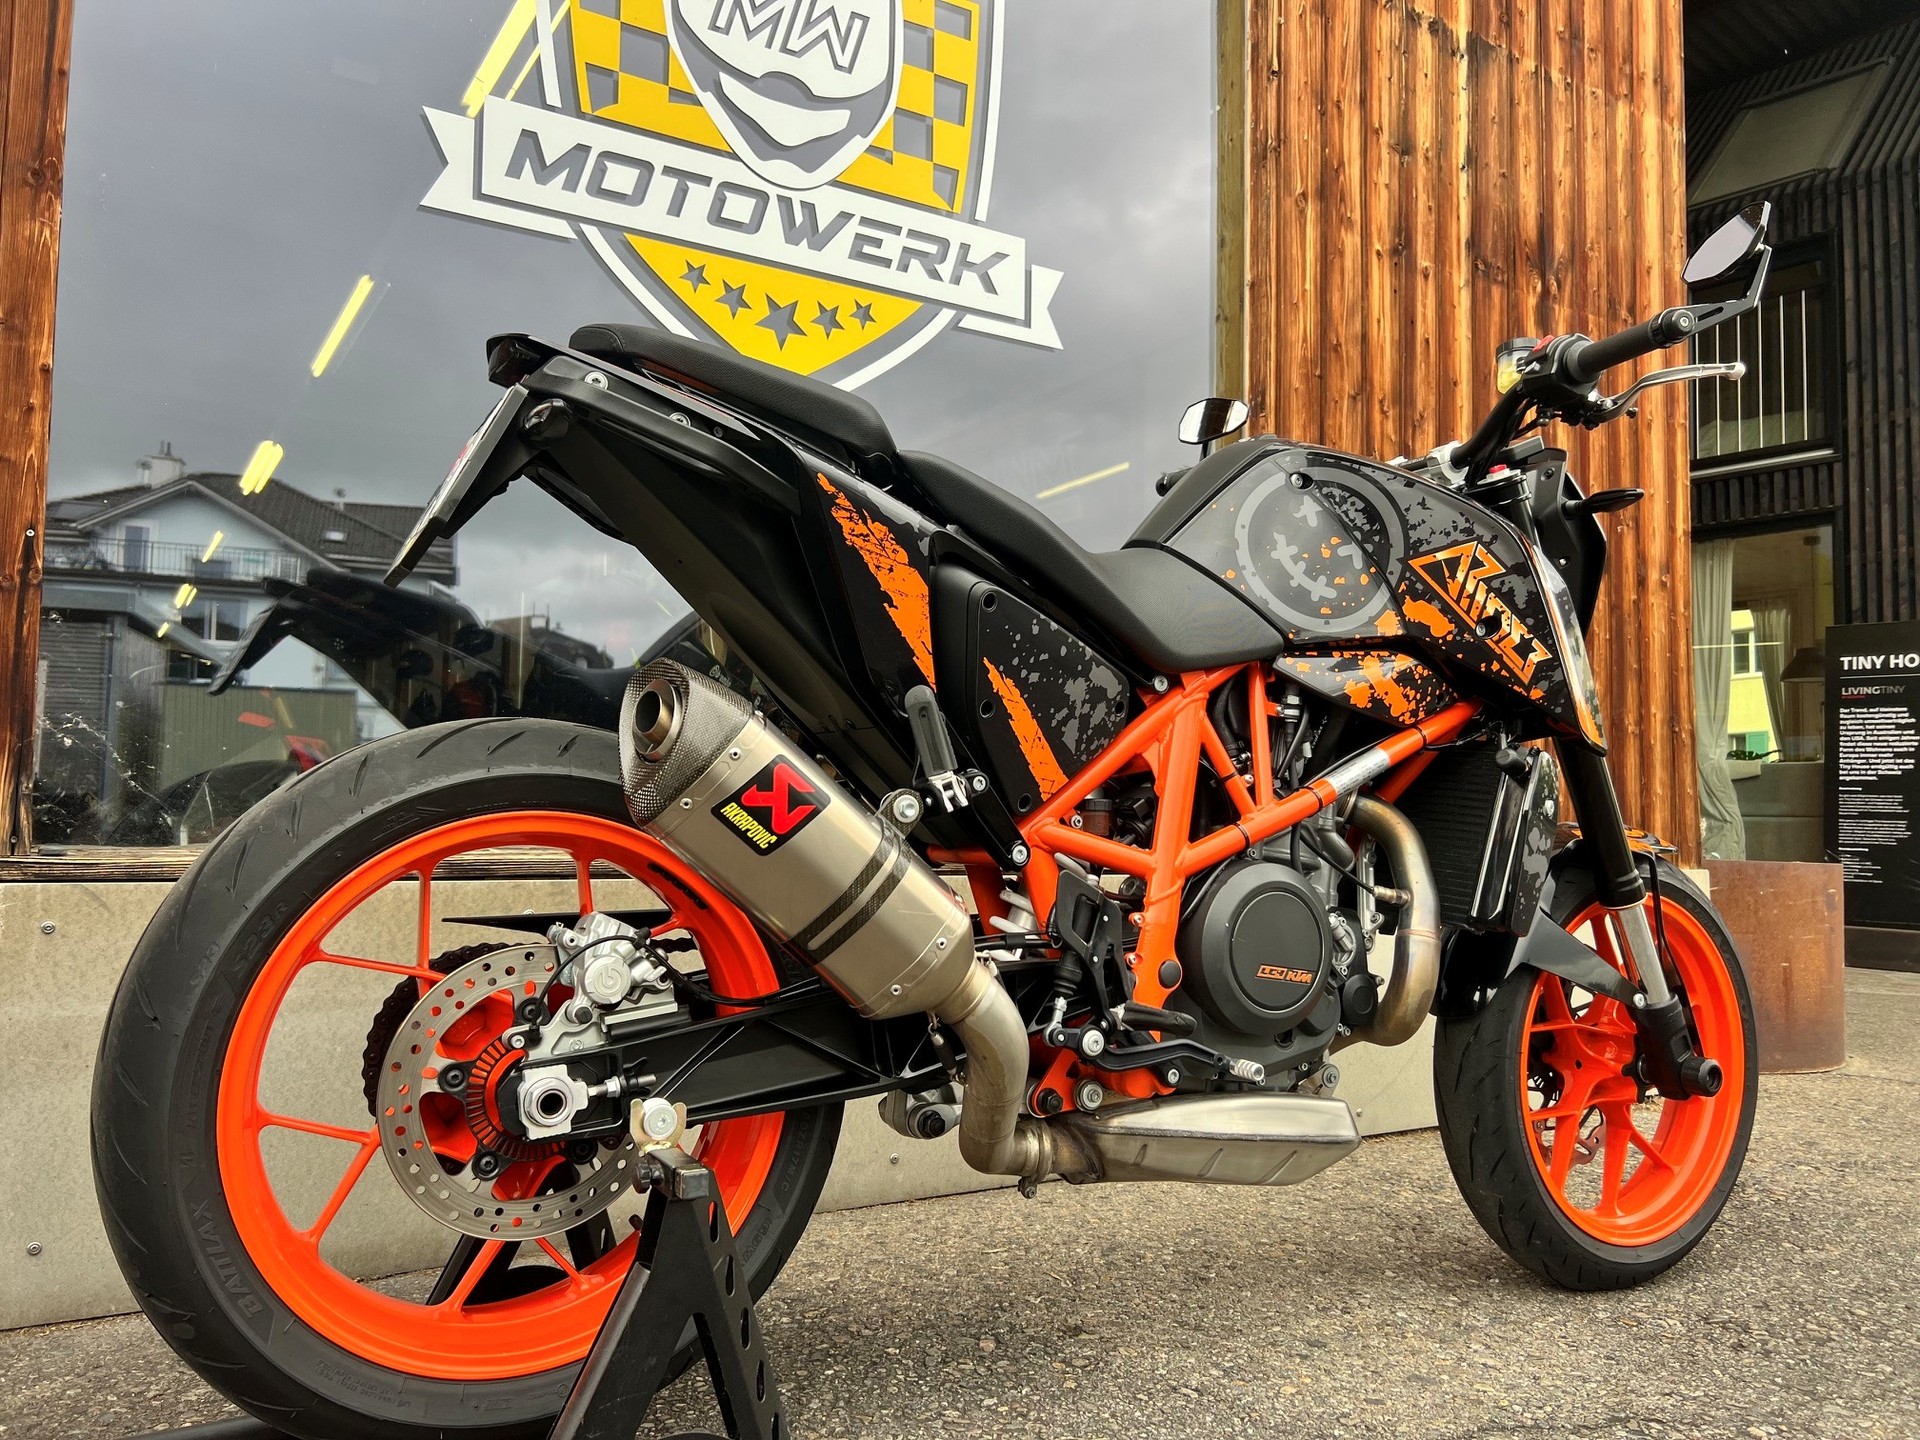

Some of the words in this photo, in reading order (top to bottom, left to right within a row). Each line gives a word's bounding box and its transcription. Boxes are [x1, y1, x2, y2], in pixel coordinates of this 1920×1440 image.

[708, 0, 870, 74] MW
[504, 128, 1010, 296] MOTOWERK
[1840, 655, 1886, 670] TINY
[1889, 653, 1920, 668] HO
[1842, 685, 1906, 695] LIVINGTINY
[1286, 969, 1312, 983] KTM
[190, 1200, 265, 1319] BATLAX
